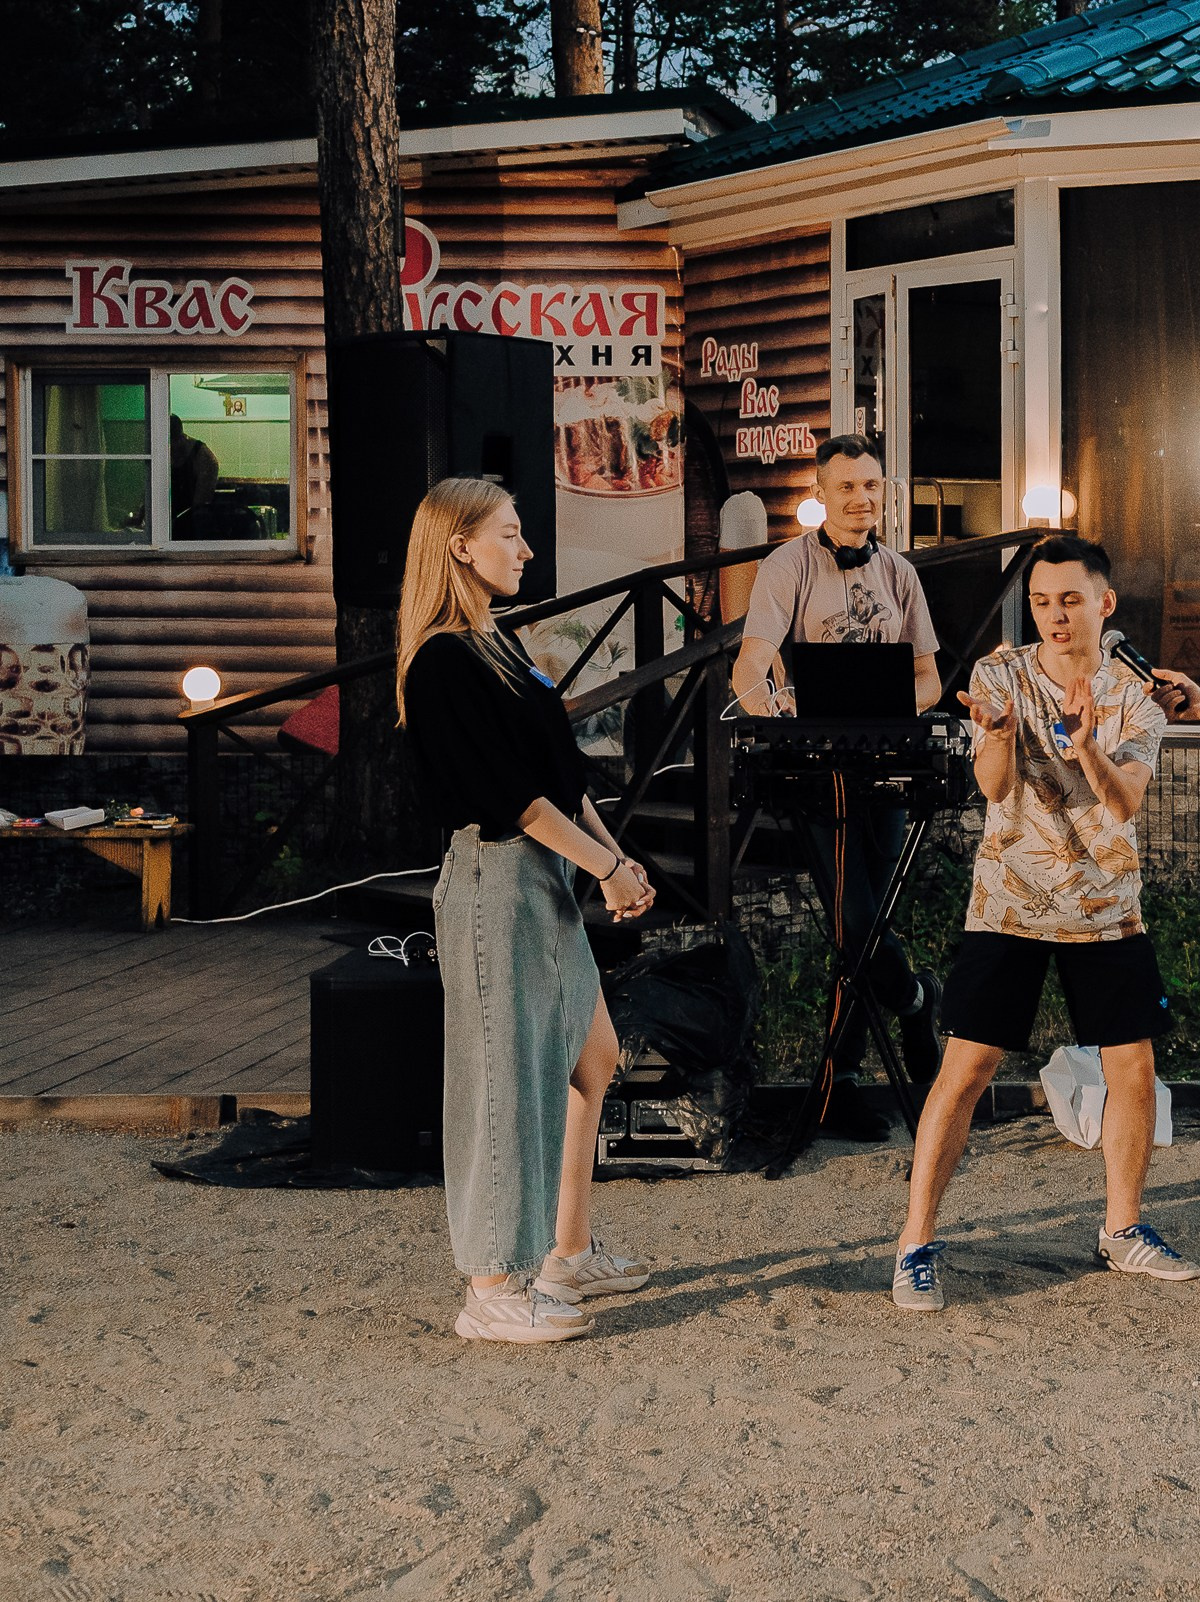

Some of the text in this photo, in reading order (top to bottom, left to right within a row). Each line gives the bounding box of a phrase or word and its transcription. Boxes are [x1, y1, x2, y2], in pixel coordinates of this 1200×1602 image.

[71, 264, 251, 332] Квас
[553, 344, 653, 367] ХНЯ
[701, 339, 758, 380] Рады
[741, 380, 778, 416] Вас
[737, 426, 815, 462] видеть
